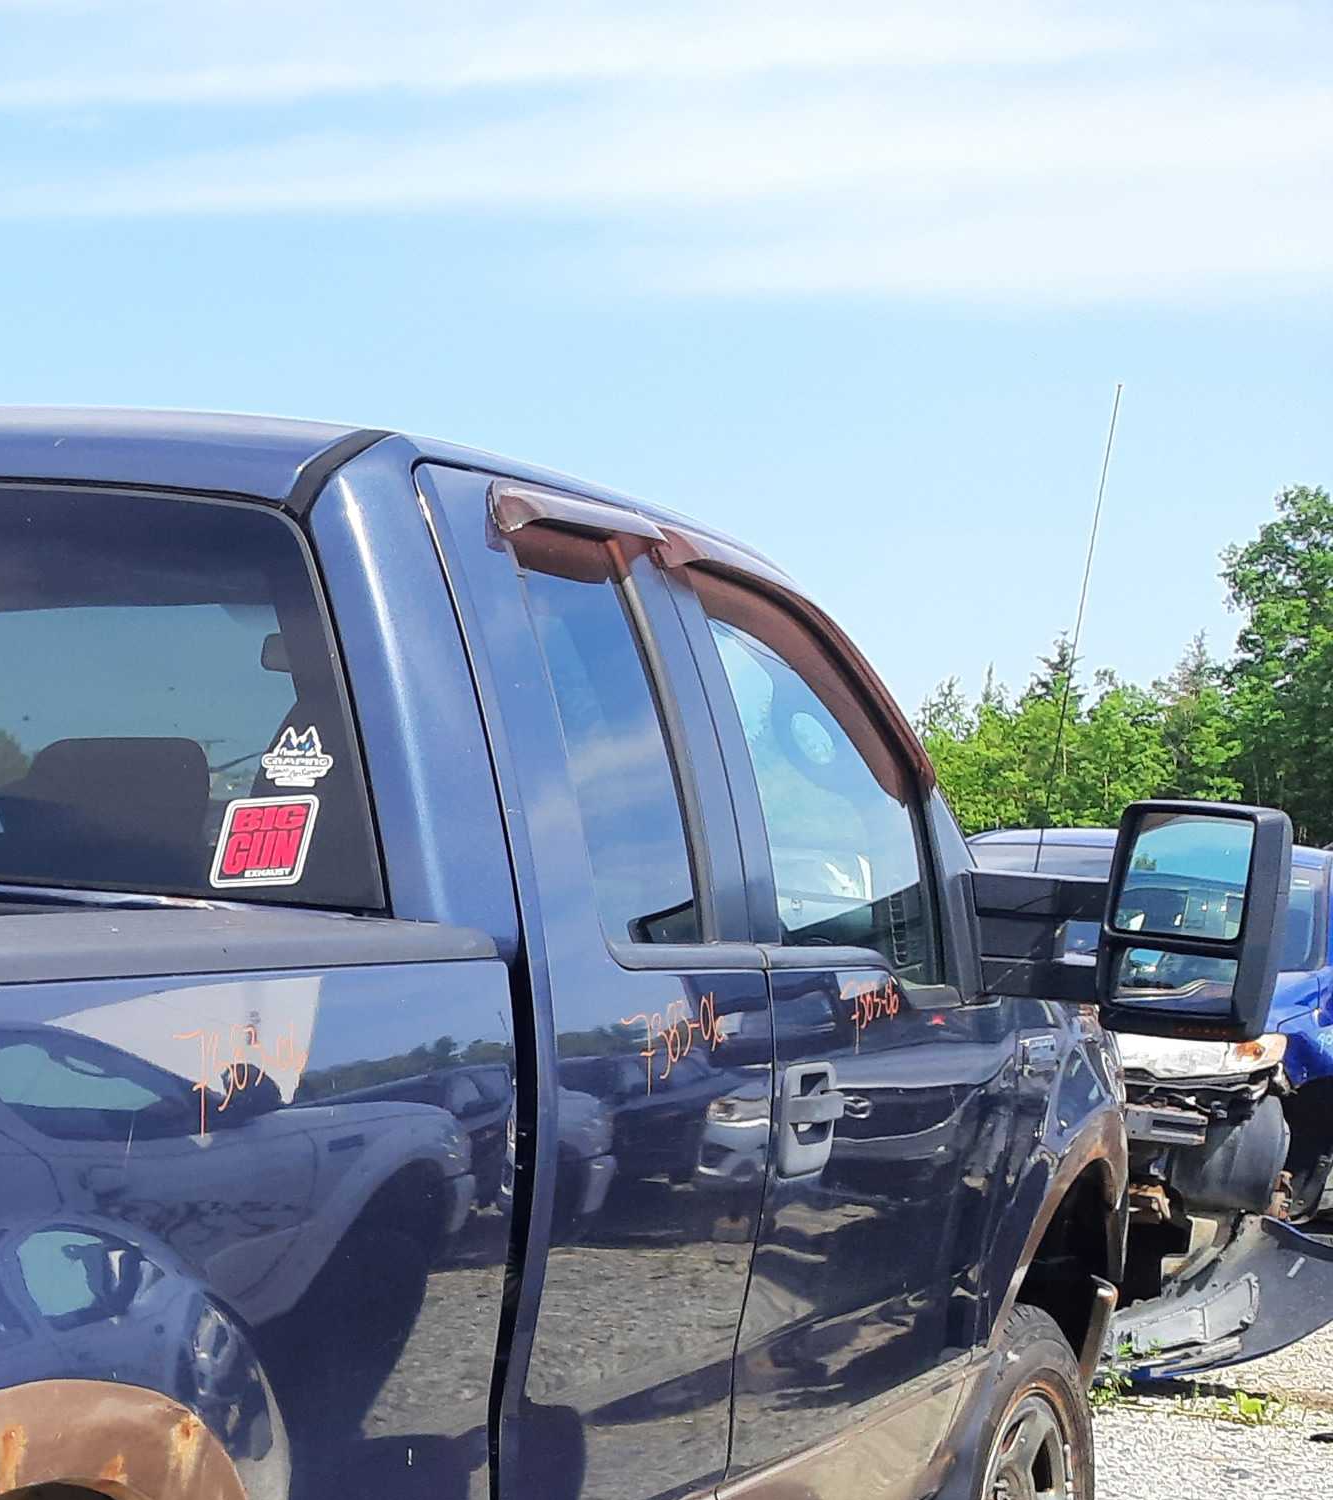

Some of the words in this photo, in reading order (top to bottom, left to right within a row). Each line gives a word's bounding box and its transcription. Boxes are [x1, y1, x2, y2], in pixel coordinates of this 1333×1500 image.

[231, 804, 308, 832] BIG
[221, 829, 302, 875] GUN
[244, 868, 292, 878] EXHAUST
